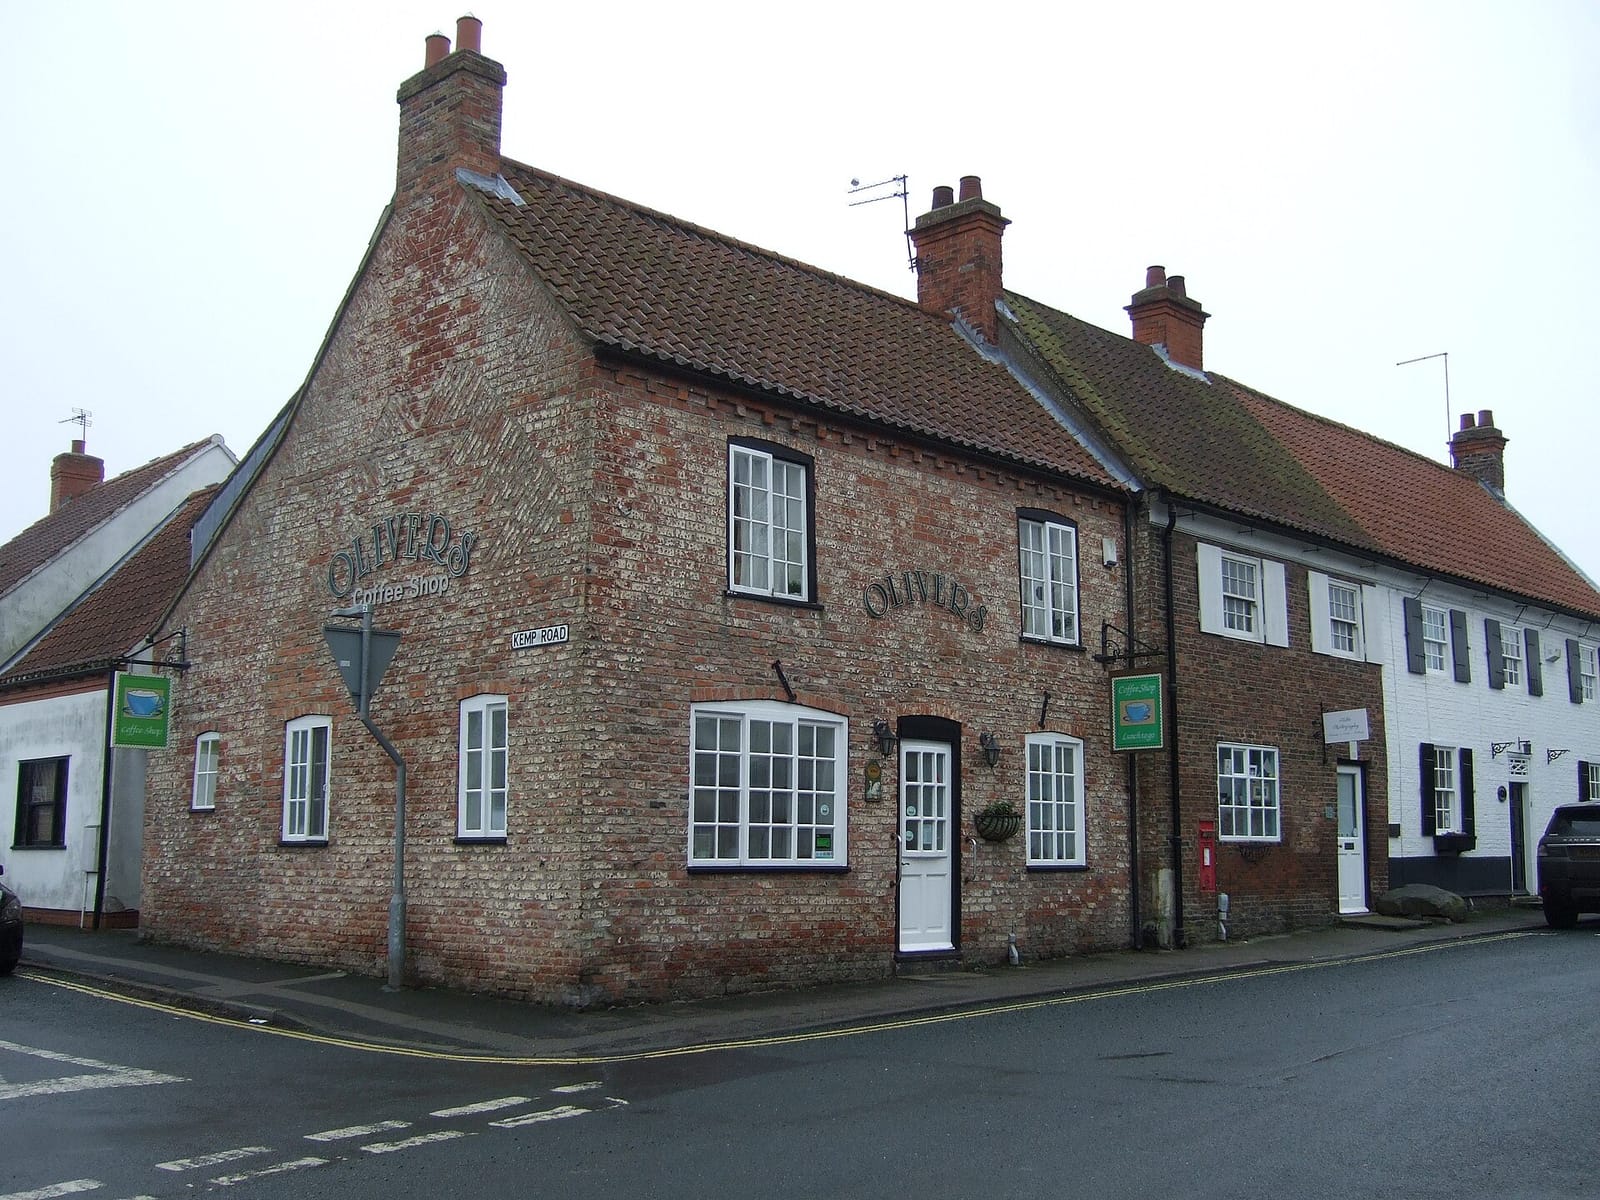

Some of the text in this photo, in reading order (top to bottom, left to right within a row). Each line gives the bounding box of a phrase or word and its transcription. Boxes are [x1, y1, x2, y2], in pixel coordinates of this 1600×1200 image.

[328, 512, 475, 597] OLIVERS
[353, 574, 449, 605] Coffee Shop
[864, 571, 987, 633] OLIVERS
[513, 626, 566, 647] KEMP ROAD
[121, 724, 143, 736] Coffee
